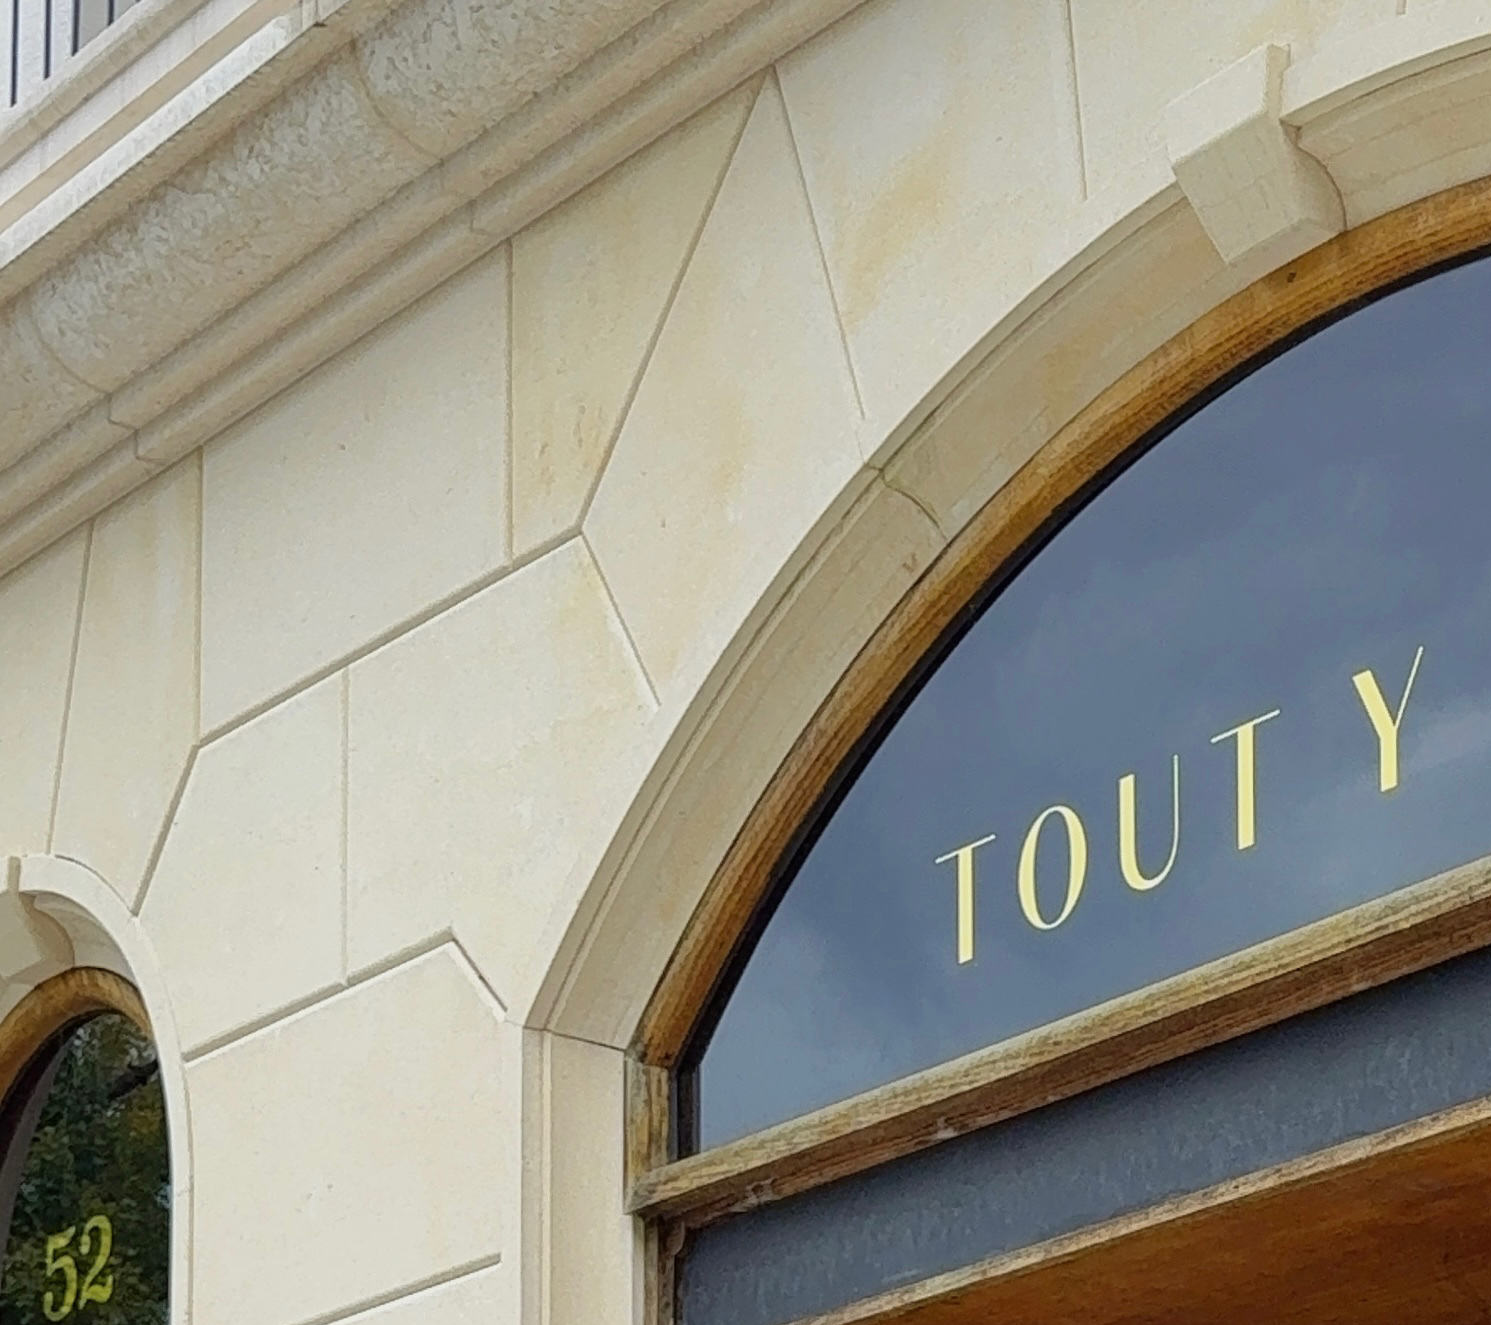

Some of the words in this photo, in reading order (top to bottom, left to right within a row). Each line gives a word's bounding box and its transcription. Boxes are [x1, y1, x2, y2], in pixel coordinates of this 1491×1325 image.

[935, 709, 1281, 965] TOUT
[1351, 646, 1424, 793] Y
[43, 1214, 114, 1322] 52
